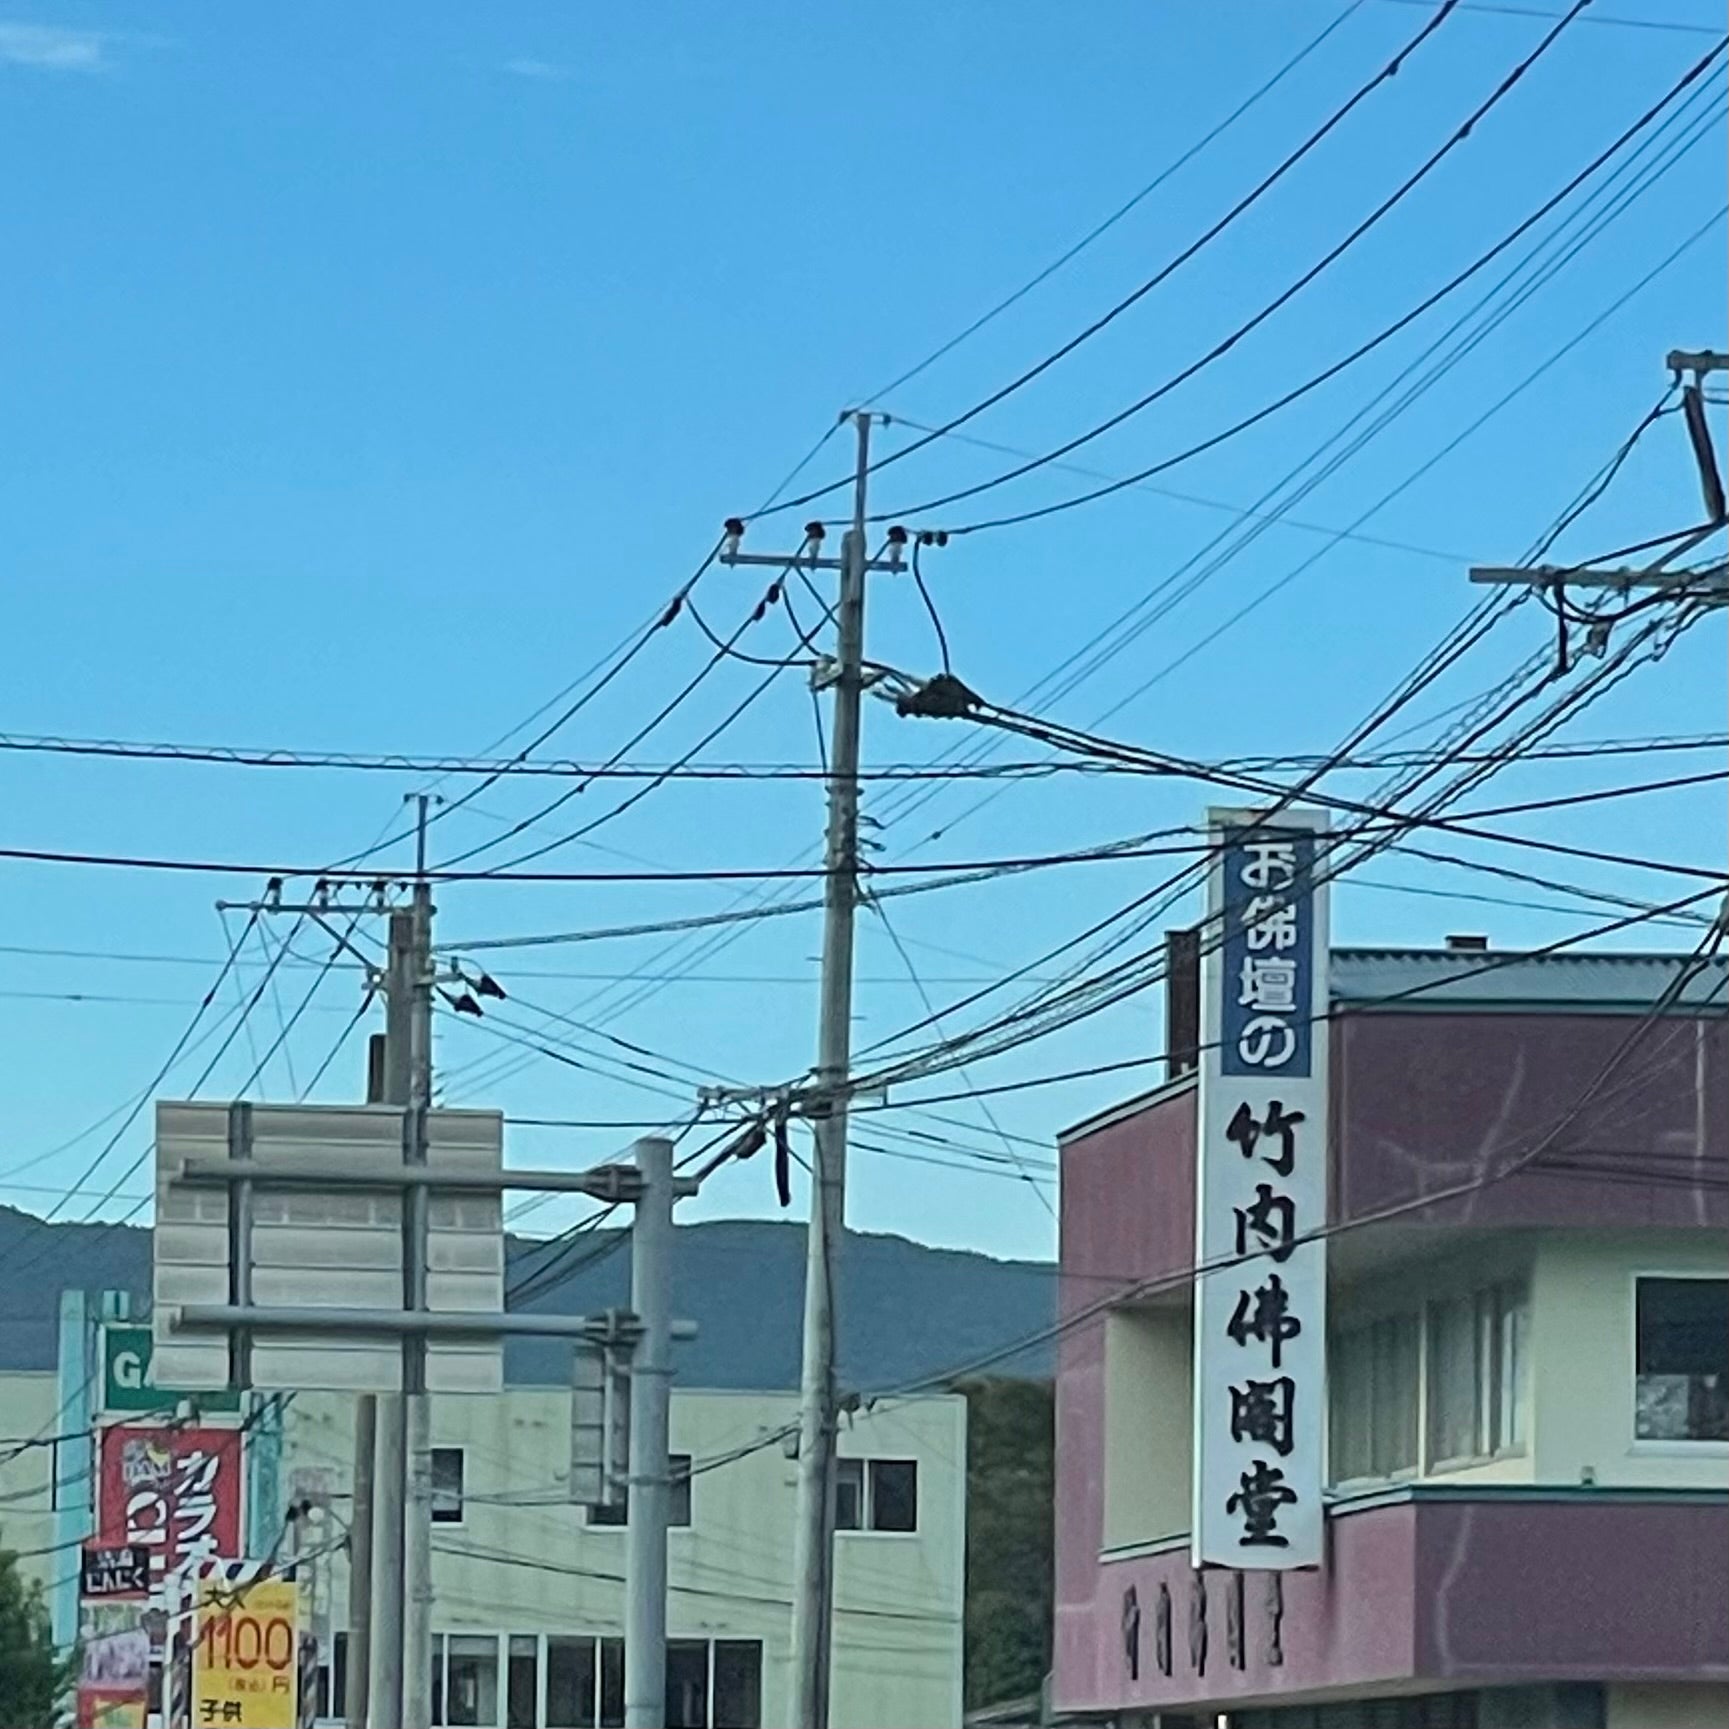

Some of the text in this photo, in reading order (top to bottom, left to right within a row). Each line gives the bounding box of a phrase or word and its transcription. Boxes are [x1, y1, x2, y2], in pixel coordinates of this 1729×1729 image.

[201, 1616, 293, 1670] 1100
[272, 1675, 291, 1694] 円
[200, 1699, 242, 1722] 子供
